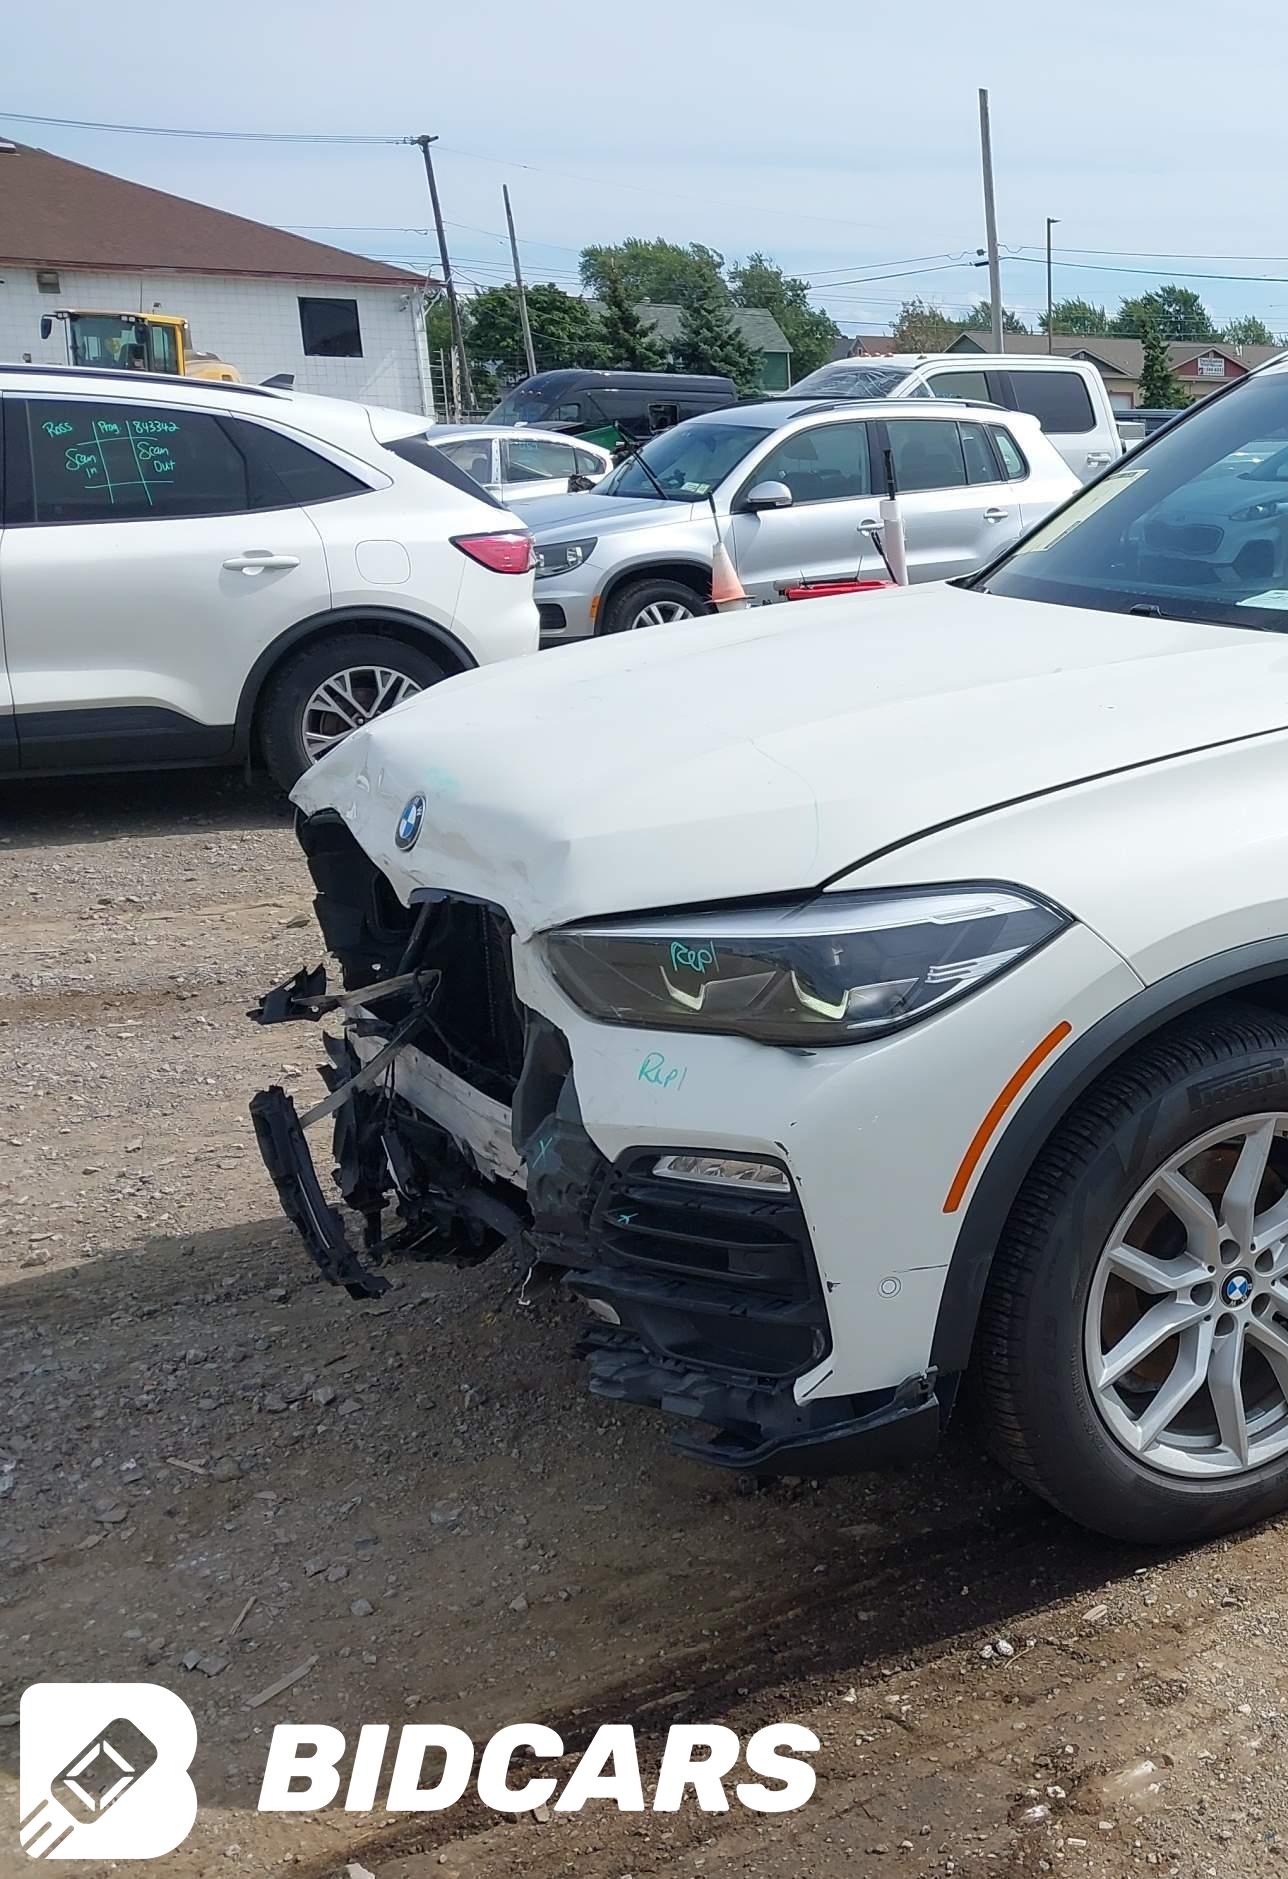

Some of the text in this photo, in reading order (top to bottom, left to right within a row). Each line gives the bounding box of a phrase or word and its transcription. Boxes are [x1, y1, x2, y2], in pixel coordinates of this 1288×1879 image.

[42, 421, 74, 438] Ross
[132, 420, 181, 434] 843342
[65, 448, 97, 471] Scan
[137, 441, 169, 460] Scan
[153, 460, 177, 473] Out
